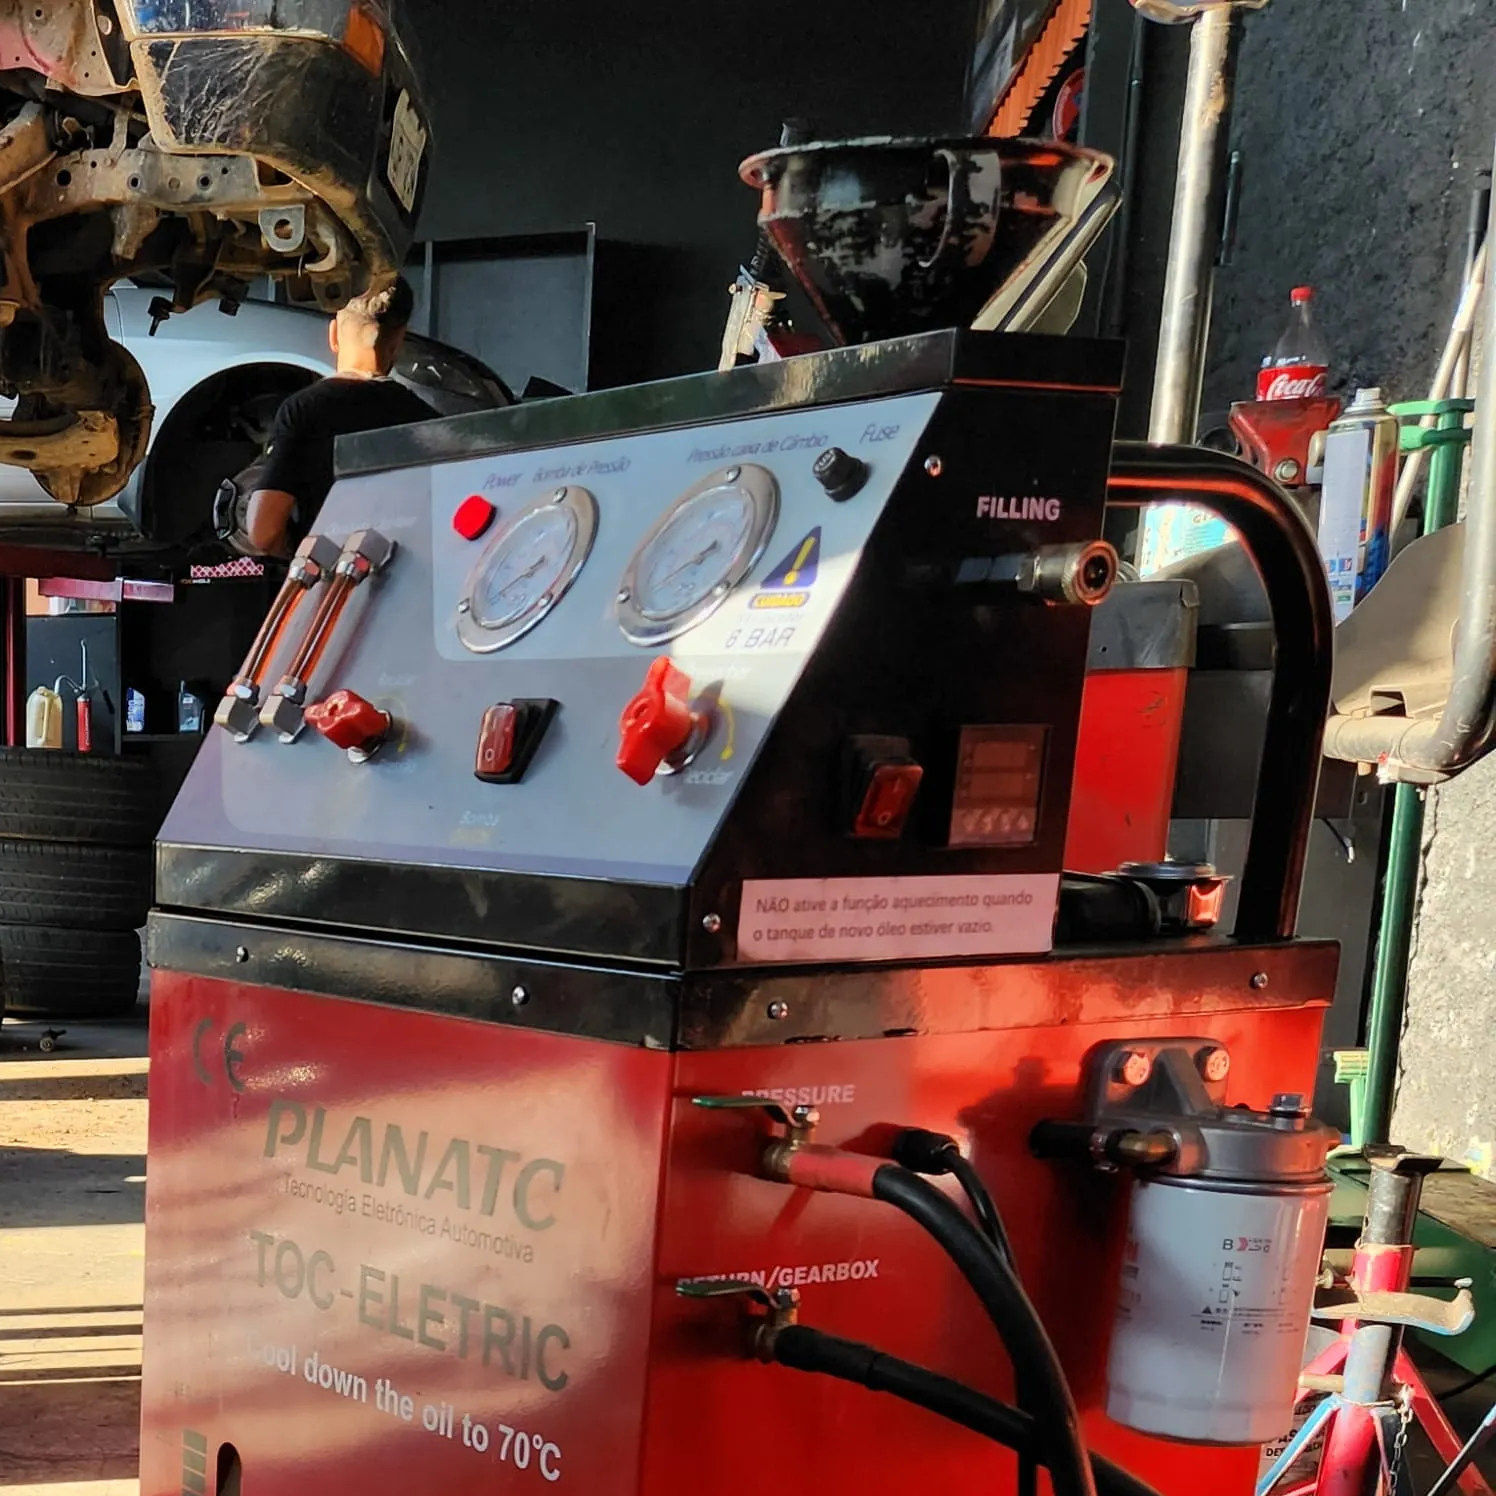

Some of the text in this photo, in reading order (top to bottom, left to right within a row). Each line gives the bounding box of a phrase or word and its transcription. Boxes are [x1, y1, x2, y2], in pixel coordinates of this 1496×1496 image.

[859, 423, 901, 444] Fuse
[482, 472, 524, 490] Power
[976, 496, 1060, 521] FILLING
[744, 626, 796, 648] BAR
[756, 889, 1034, 917] NÃO ative a função aquecimento quando
[753, 929, 762, 941] o
[766, 925, 814, 944] tanque
[818, 922, 835, 939] de
[838, 926, 874, 939] novo
[876, 921, 906, 938] óleo
[910, 921, 953, 937] estiver
[263, 1098, 566, 1231] PLANATC
[283, 1171, 534, 1264] Tecnologia Eletrônica Automotiva
[250, 1230, 571, 1392] TOC-ELETRIC
[304, 1352, 367, 1404] down
[375, 1378, 413, 1422] the
[422, 1401, 454, 1439] oil
[462, 1413, 489, 1452] to
